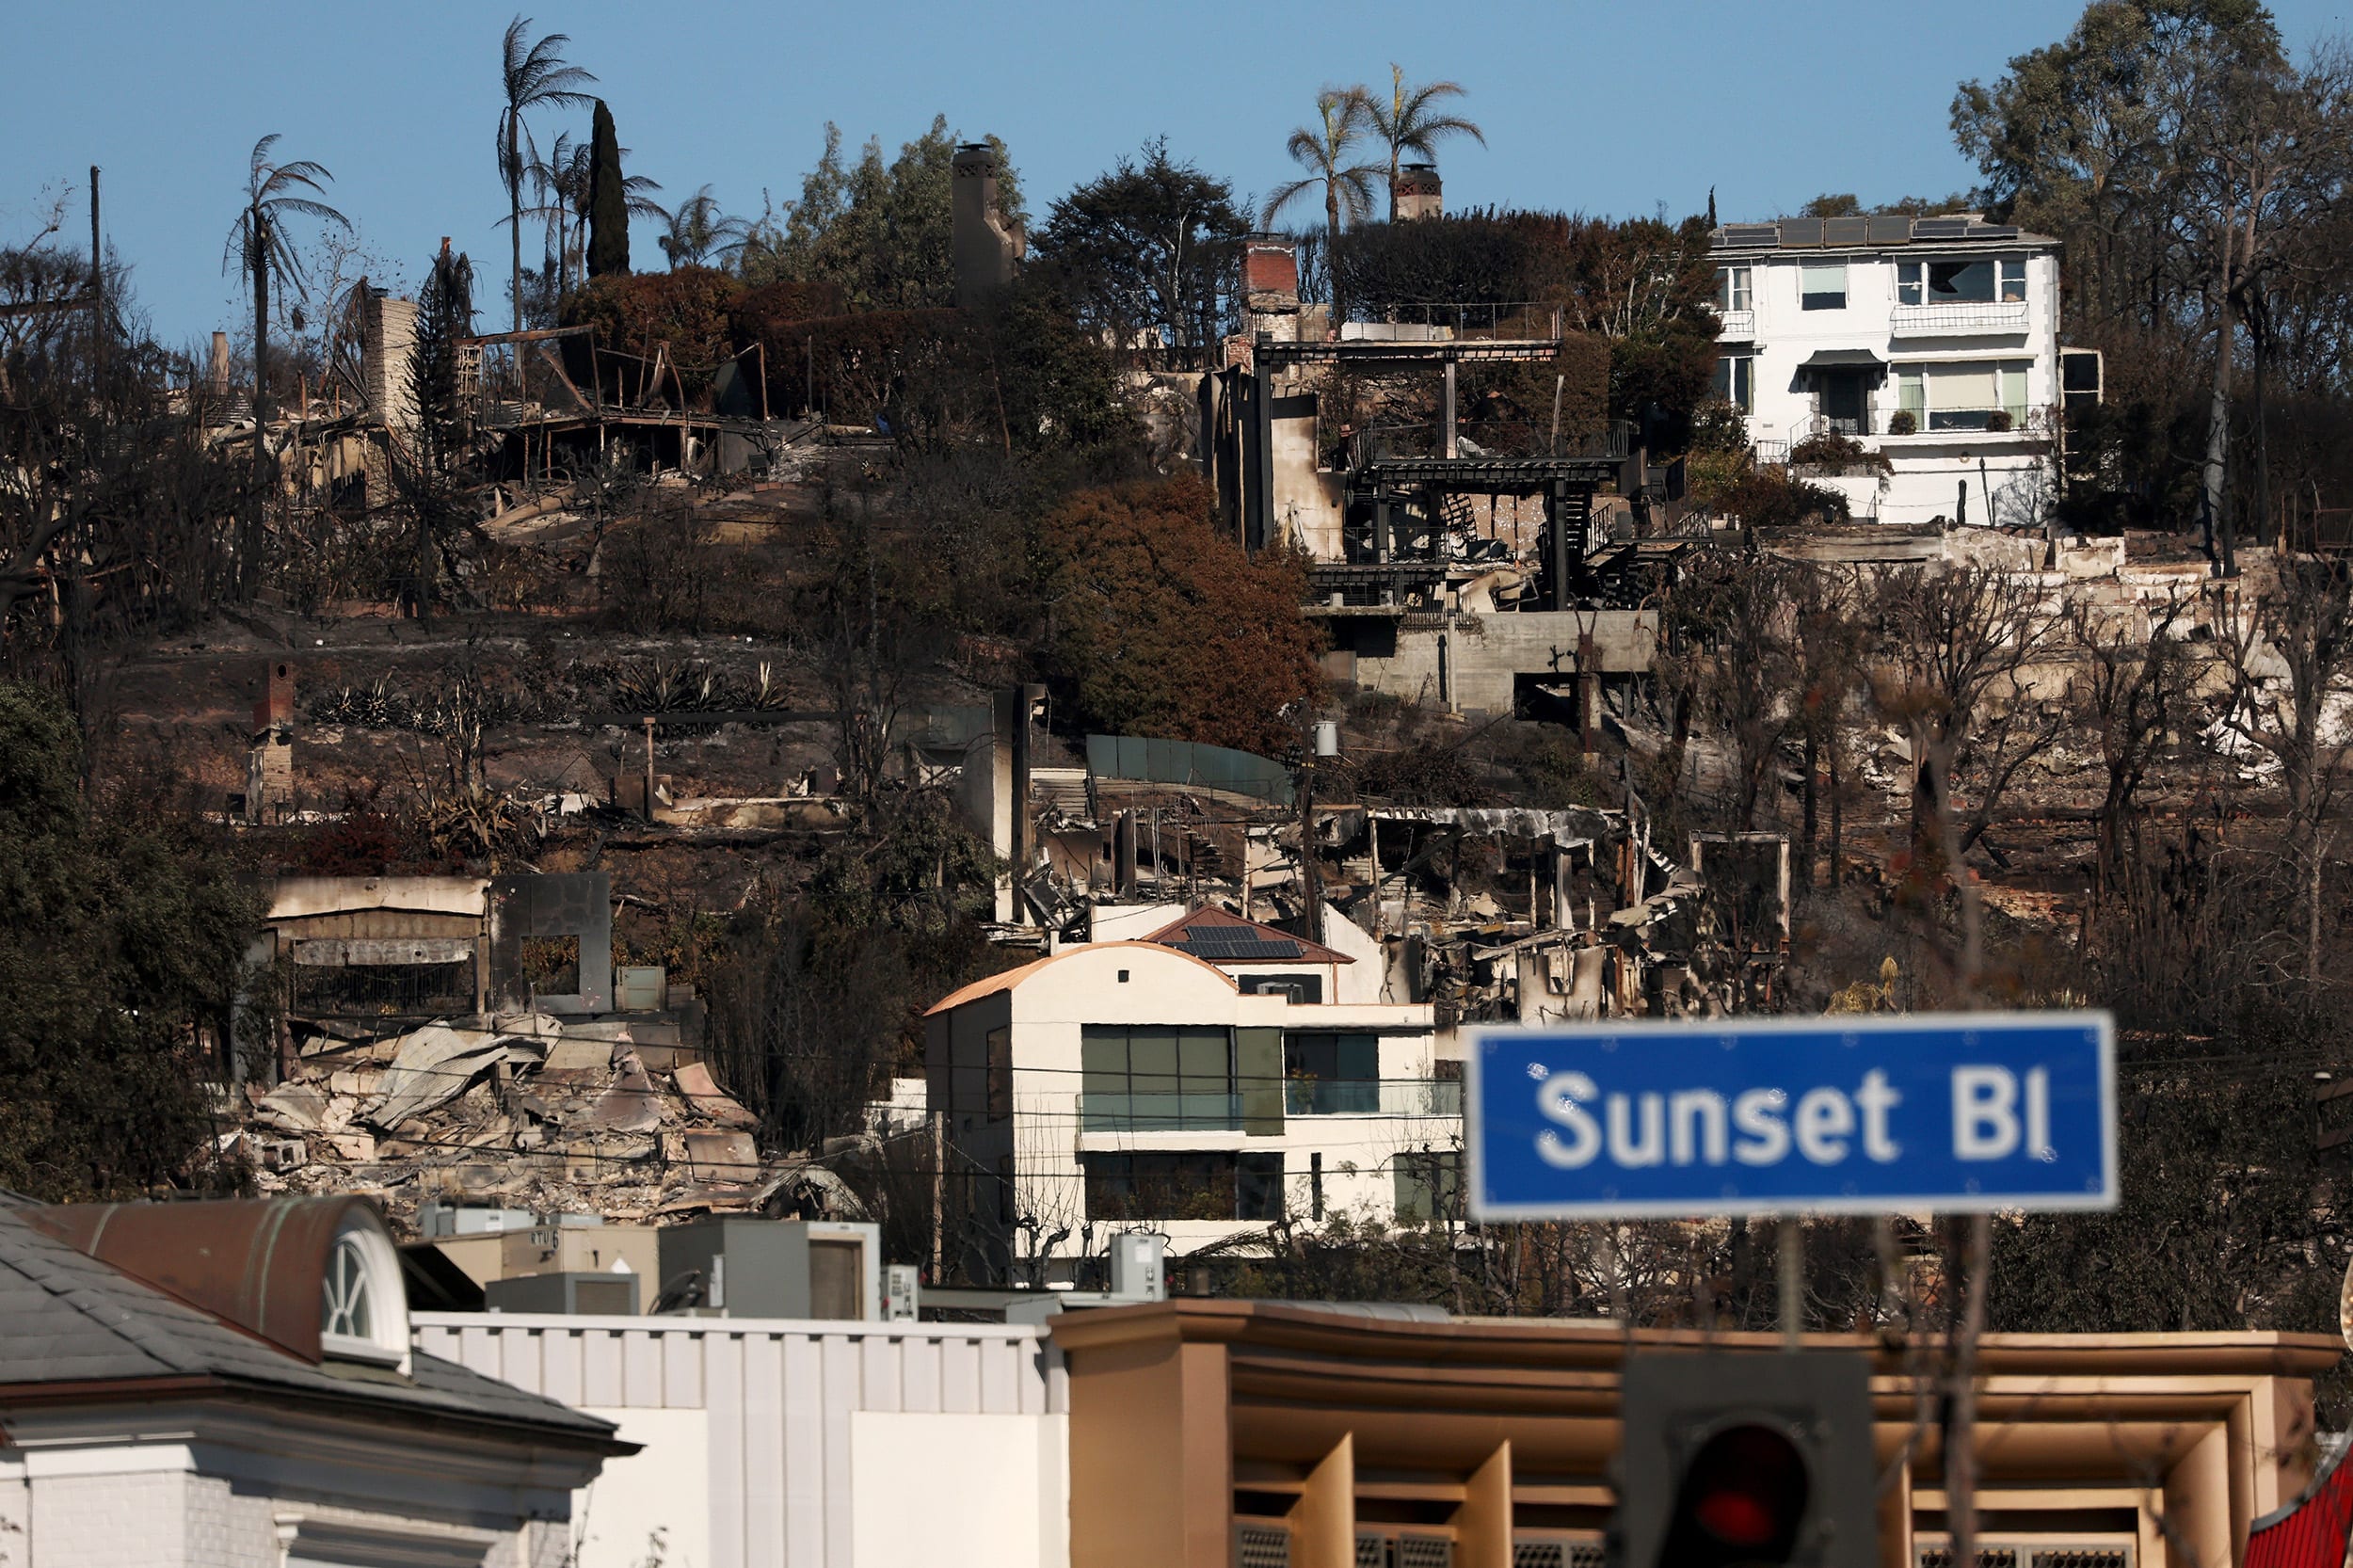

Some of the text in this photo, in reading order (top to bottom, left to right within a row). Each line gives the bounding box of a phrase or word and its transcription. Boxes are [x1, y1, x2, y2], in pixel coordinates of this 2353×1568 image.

[1535, 1064, 2049, 1170] Sunset Bl
[531, 1229, 559, 1250] RTU 6
